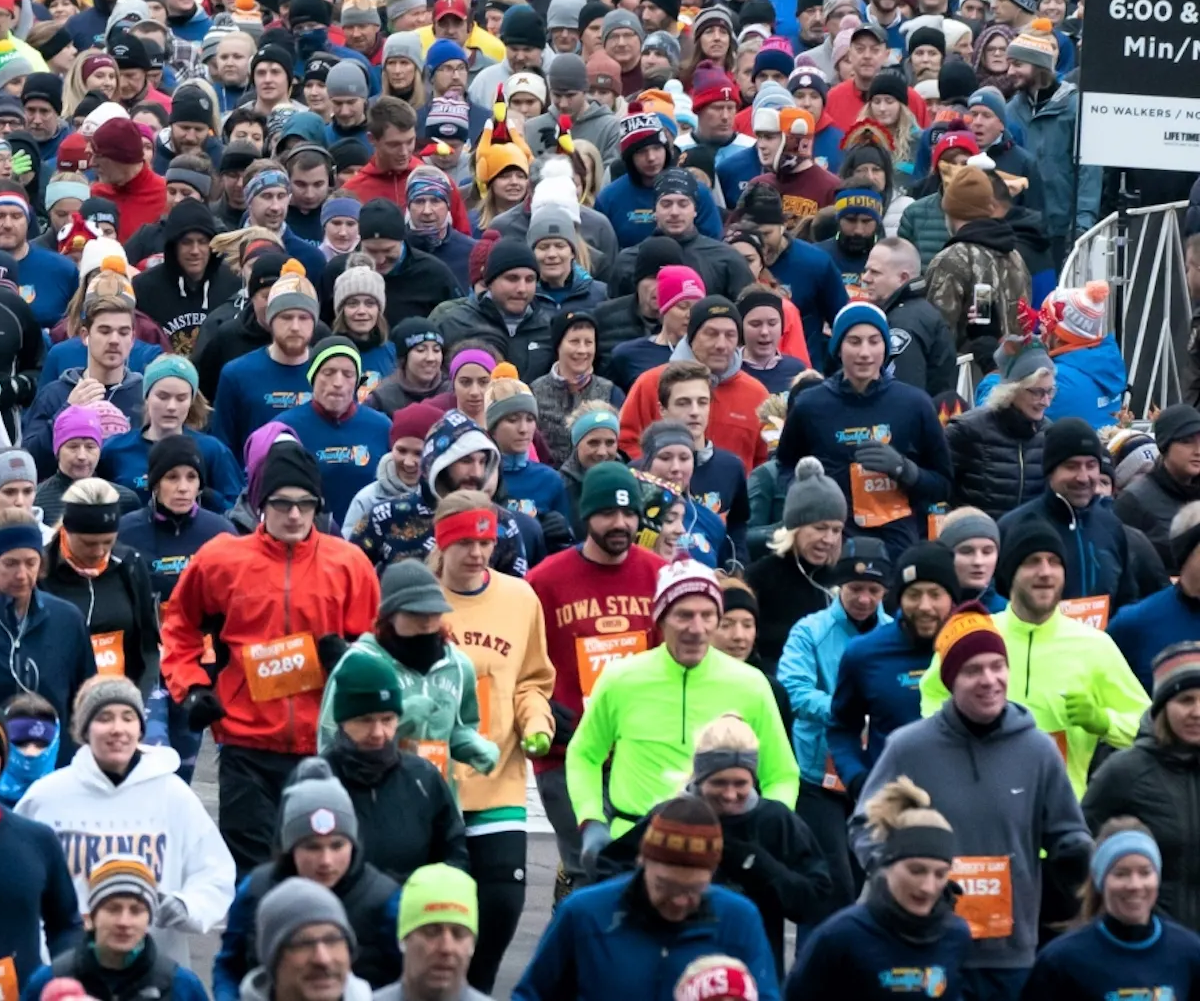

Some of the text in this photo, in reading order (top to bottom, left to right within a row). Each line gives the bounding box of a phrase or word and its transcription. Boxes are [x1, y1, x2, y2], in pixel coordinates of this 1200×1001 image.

[1089, 104, 1108, 115] NO
[1113, 106, 1171, 120] WALKERS
[1163, 130, 1179, 142] LIFE
[555, 595, 652, 628] IOWA STAT
[463, 631, 511, 658] STATE
[257, 654, 306, 678] 6289
